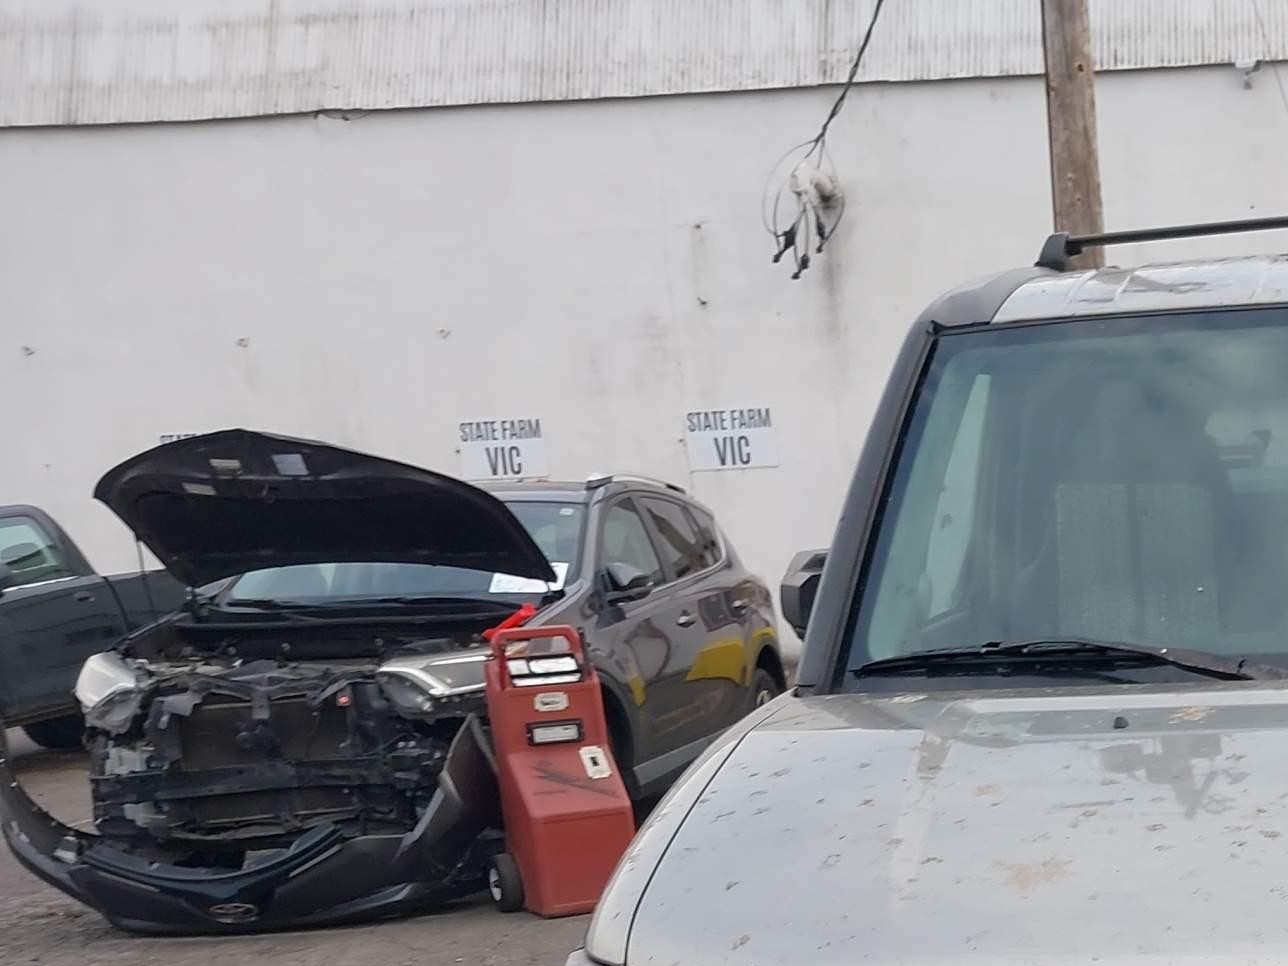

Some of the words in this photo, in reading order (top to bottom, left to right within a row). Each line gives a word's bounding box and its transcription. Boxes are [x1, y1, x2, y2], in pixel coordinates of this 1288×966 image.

[460, 420, 499, 442] STATE
[501, 418, 542, 440] FARM
[687, 410, 728, 432] STATE
[730, 407, 772, 430] FARM
[485, 445, 522, 476] VIC
[713, 435, 751, 466] VIC
